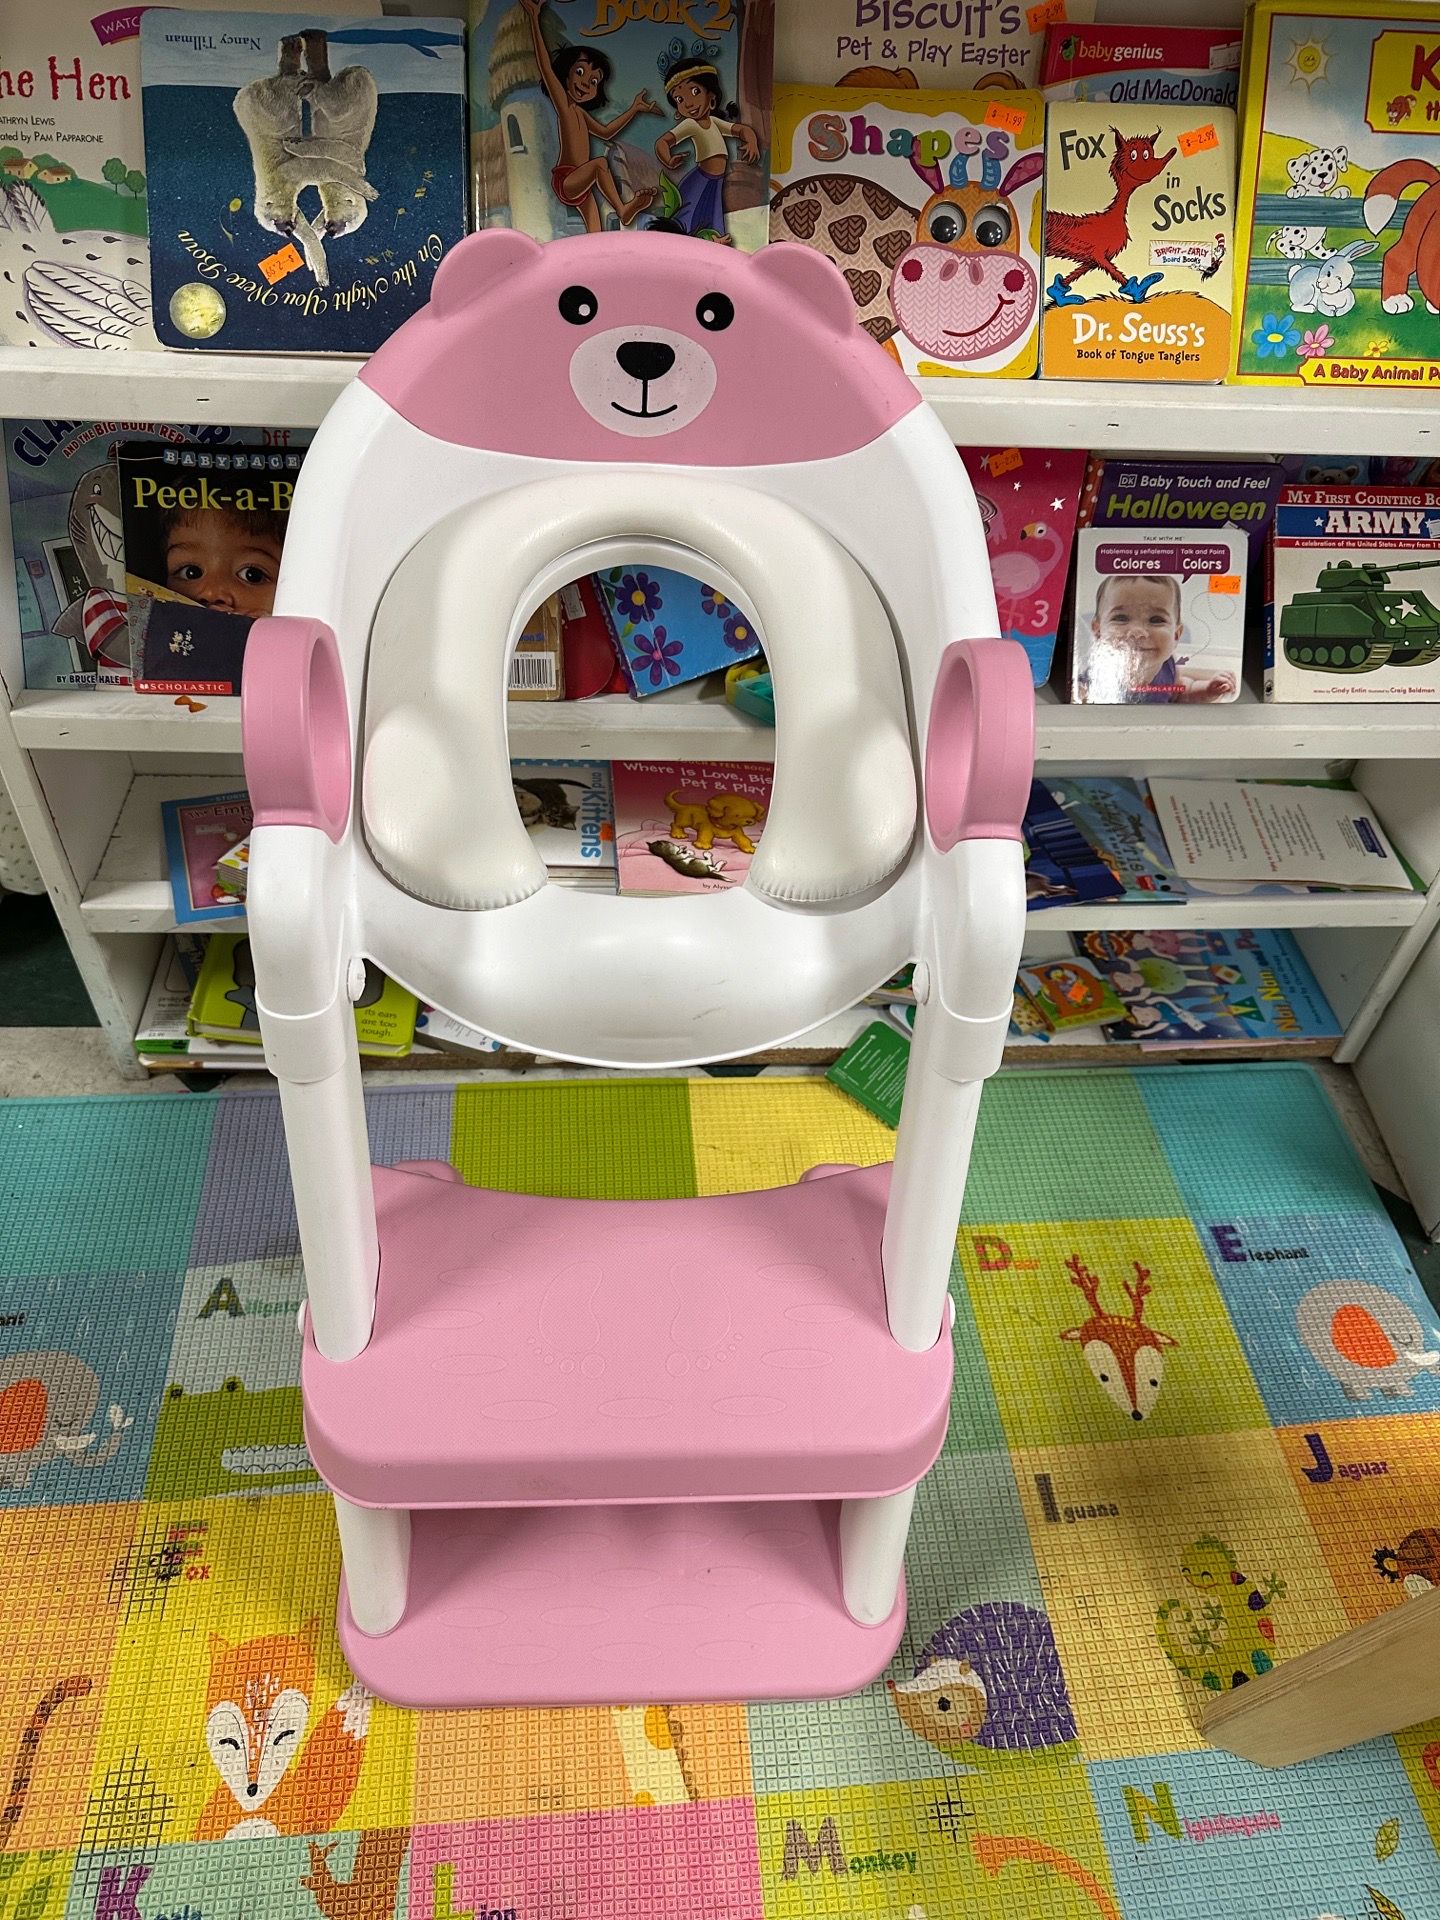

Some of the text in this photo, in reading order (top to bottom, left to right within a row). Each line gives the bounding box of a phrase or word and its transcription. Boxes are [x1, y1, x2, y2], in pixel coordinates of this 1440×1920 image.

[579, 0, 735, 40] Book 2
[856, 0, 1021, 38] Biscuit's
[165, 33, 261, 51] Nancy Tillman
[837, 36, 1030, 67] Pet & Play Easter
[48, 56, 131, 100] Hen
[1110, 79, 1140, 103] Old
[31, 115, 56, 126] LEWIS
[21, 132, 31, 143] by
[807, 114, 1010, 167] Shapes
[1059, 130, 1106, 170] Fox
[1166, 172, 1180, 189] in
[1152, 186, 1227, 231] Socks
[177, 229, 443, 316] On the Night You Were Born
[1072, 312, 1205, 347] Dr. Seuss's
[1077, 349, 1200, 364] Book of Tongue Tanglers
[1313, 364, 1325, 378] A
[1331, 364, 1368, 382] Baby
[1372, 365, 1424, 380] Animal
[13, 419, 82, 467] CLA
[62, 441, 80, 458] AND
[78, 430, 95, 445] THE
[94, 422, 117, 437] BIG
[120, 422, 155, 433] BOOK
[164, 449, 300, 469] BABYFACE
[132, 477, 294, 511] Peek-a-B
[1119, 475, 1271, 490] DK Baby Touch and Feel
[1106, 493, 1267, 521] Halloween
[1325, 510, 1425, 534] ARMY
[1113, 558, 1161, 570] Colores
[1182, 558, 1222, 570] Colors
[1031, 600, 1049, 628] 3
[57, 675, 120, 684] BY BRUCE HALE
[149, 681, 225, 692] SCHOLASTIC
[624, 762, 674, 774] Where
[681, 767, 696, 777] Is
[749, 774, 773, 785] Bis
[680, 778, 766, 796] Pet & Play
[581, 771, 604, 858] and Kittens
[380, 1020, 397, 1028] too
[1210, 1225, 1310, 1262] Elephant
[1301, 1433, 1389, 1483] Jaguar
[1034, 1473, 1120, 1523] Iguana
[780, 1816, 917, 1881] Monkey
